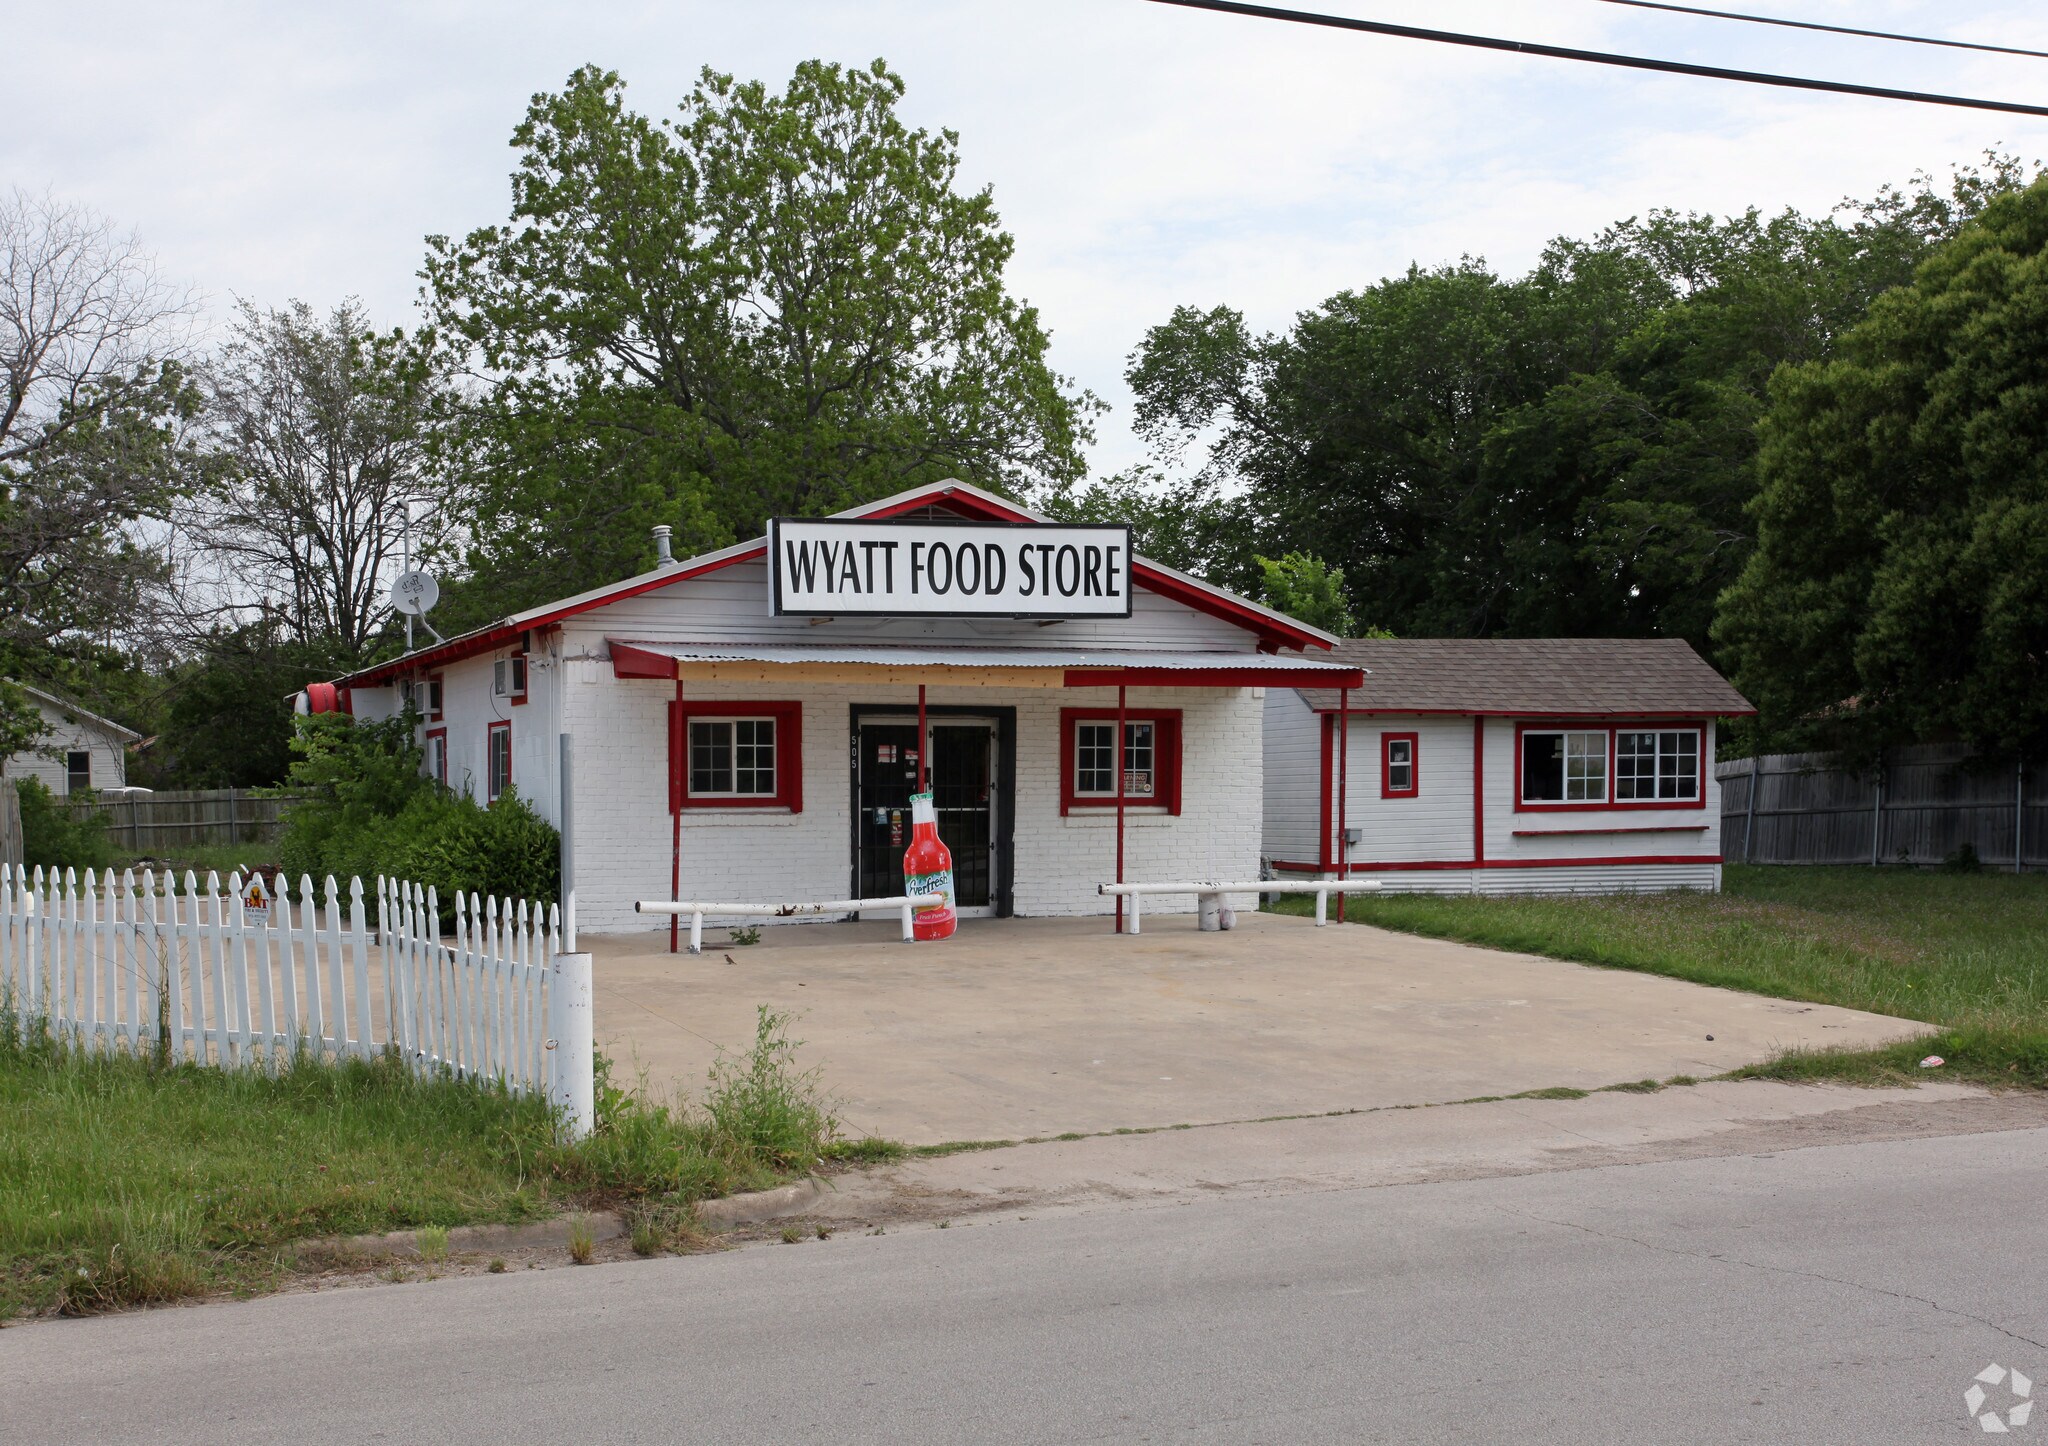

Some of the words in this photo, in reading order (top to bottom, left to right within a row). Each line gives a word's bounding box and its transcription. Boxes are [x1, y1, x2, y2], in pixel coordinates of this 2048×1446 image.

[786, 540, 899, 594] WYATT
[911, 541, 1006, 596] FOOD
[1018, 543, 1120, 597] STORE
[401, 574, 419, 593] dish
[909, 871, 948, 895] Everfresh
[244, 897, 269, 909] BAT
